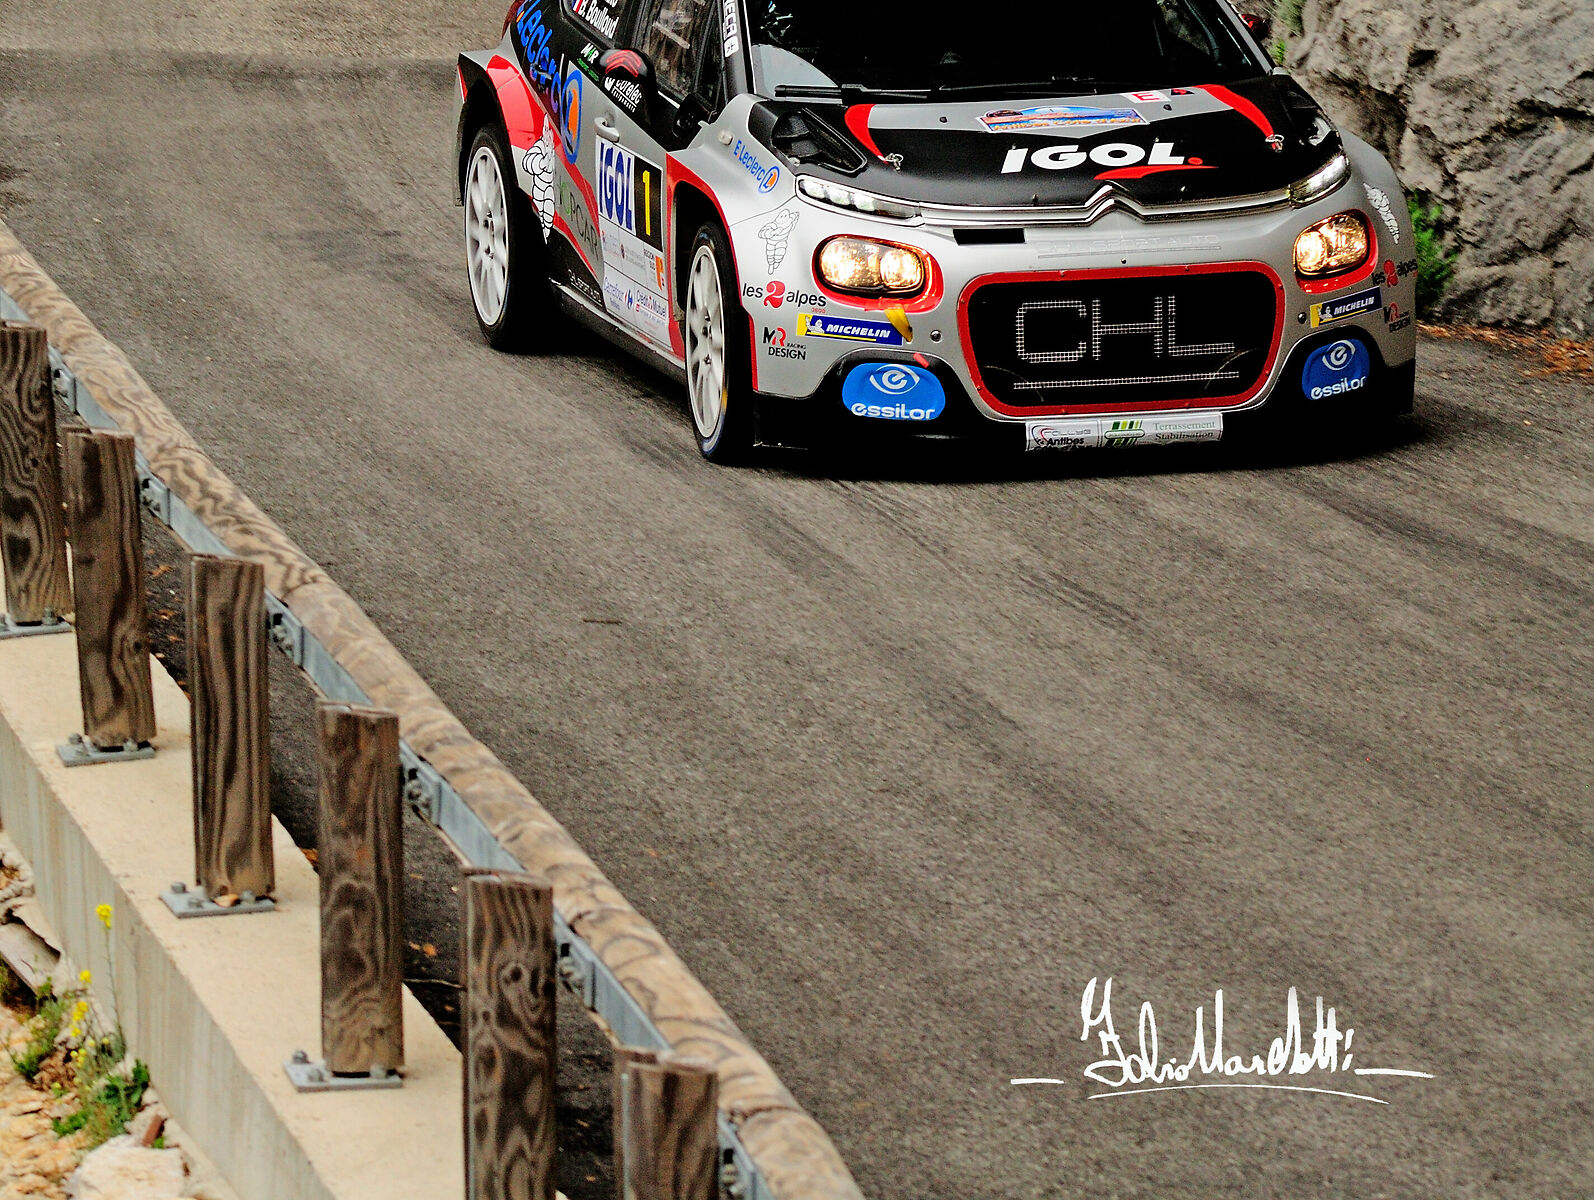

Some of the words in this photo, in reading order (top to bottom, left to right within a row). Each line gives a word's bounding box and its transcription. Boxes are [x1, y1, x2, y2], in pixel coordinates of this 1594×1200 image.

[600, 142, 632, 230] IGOL
[642, 170, 651, 237] 1
[742, 283, 763, 299] les
[763, 280, 786, 309] 2
[786, 290, 827, 308] alpes
[1333, 296, 1375, 315] MICHELIN
[825, 324, 891, 339] MICHELIN
[1016, 295, 1236, 364] CHL
[768, 346, 807, 361] DESIGN
[851, 402, 936, 420] essilor
[1153, 420, 1216, 431] Terrassement
[1047, 437, 1085, 446] Antibes
[1154, 431, 1214, 441] Stabilisation
